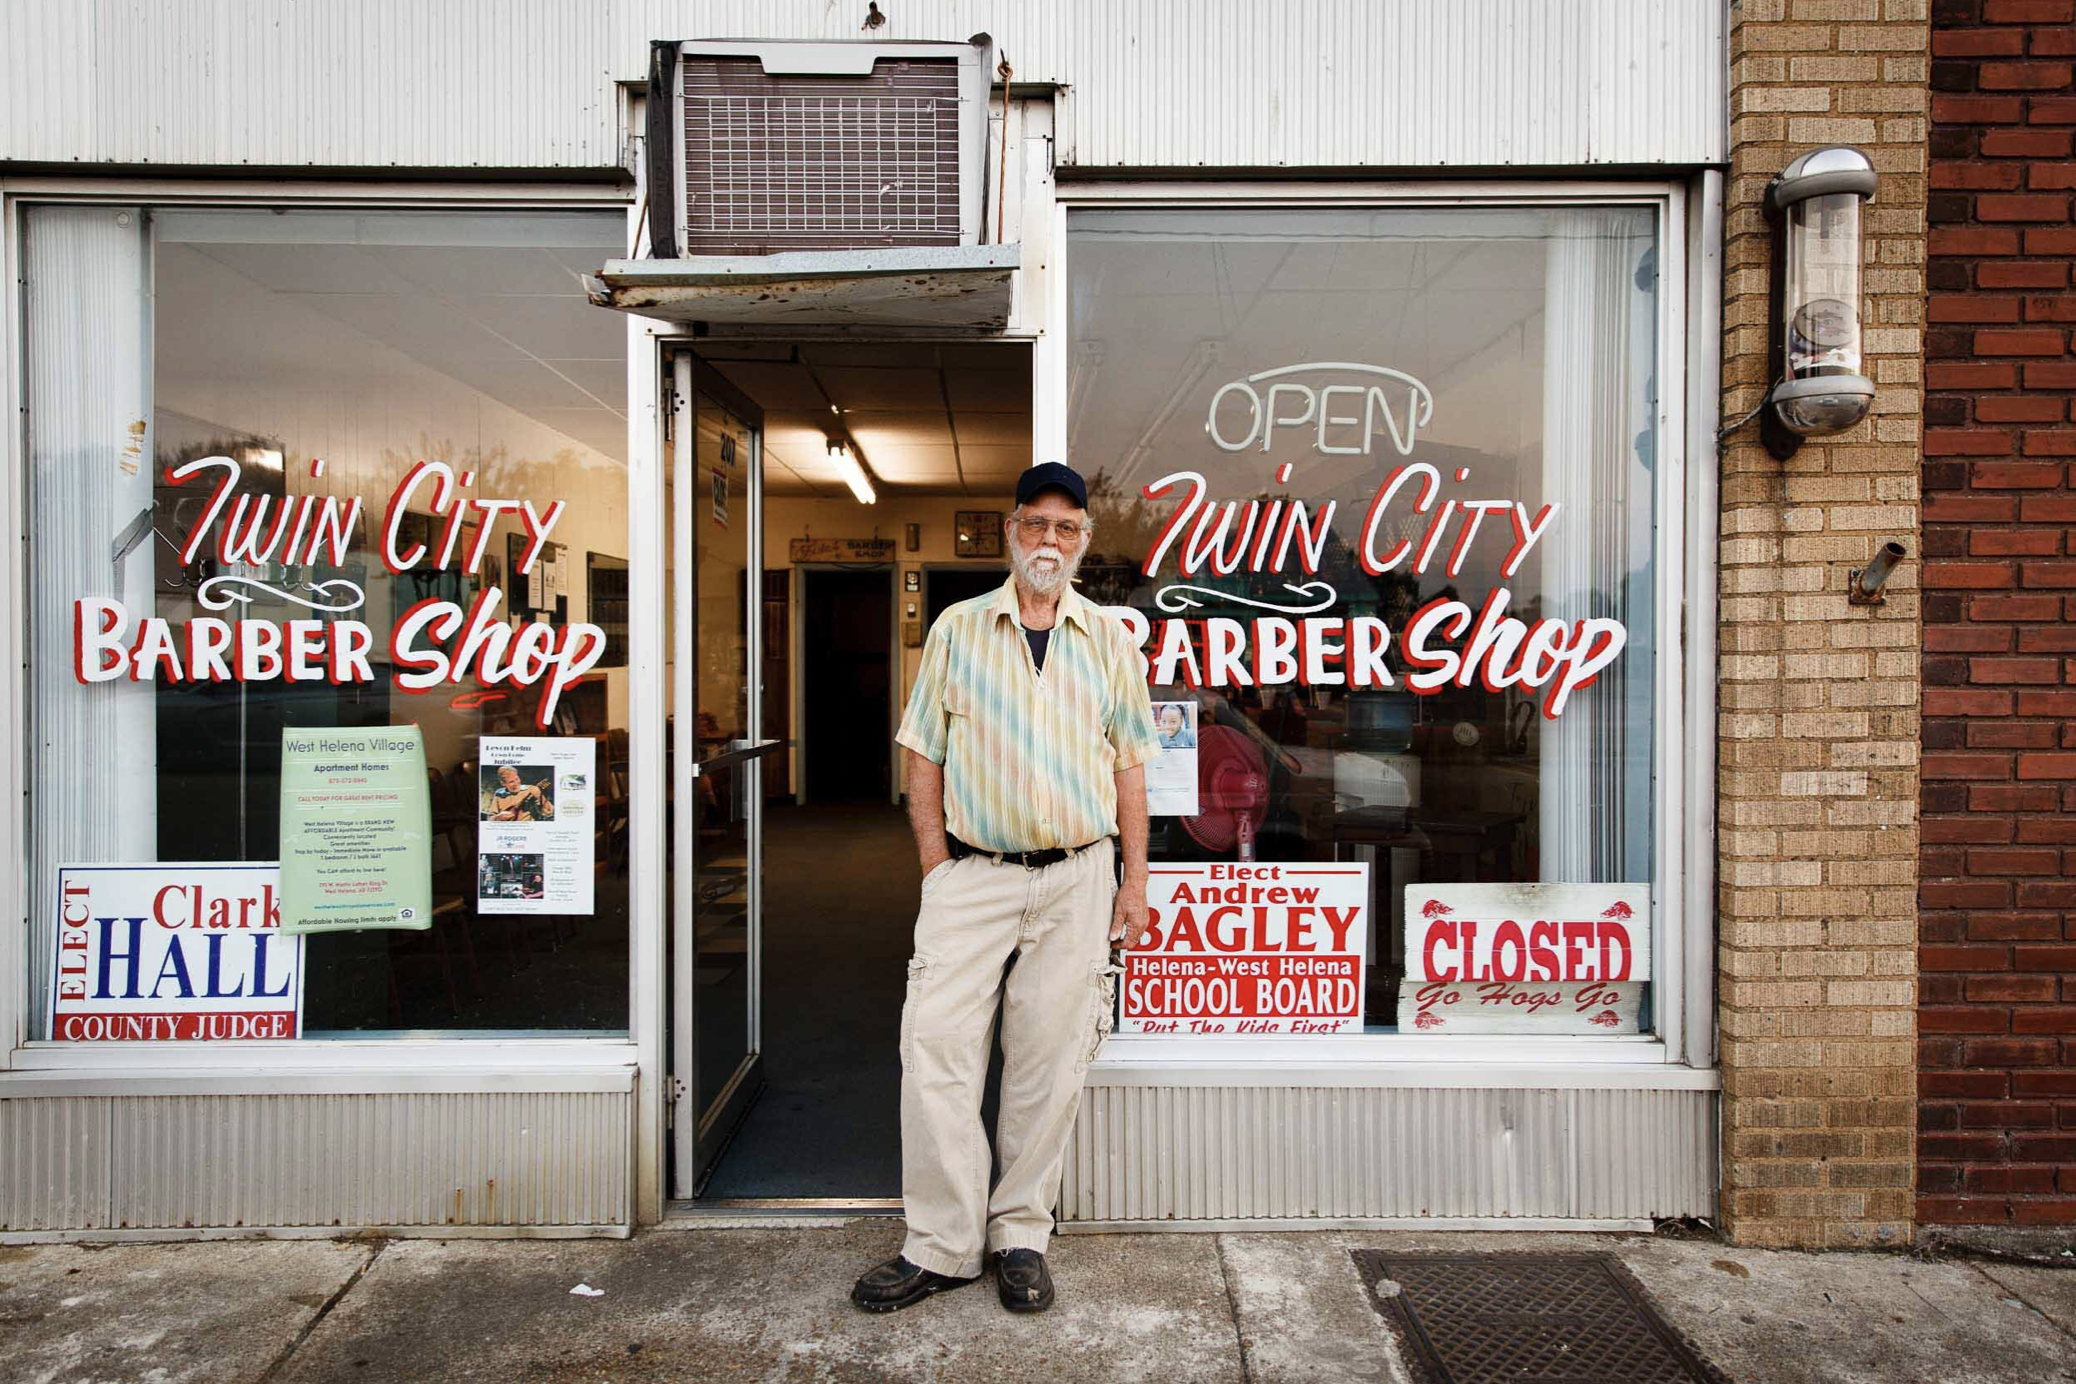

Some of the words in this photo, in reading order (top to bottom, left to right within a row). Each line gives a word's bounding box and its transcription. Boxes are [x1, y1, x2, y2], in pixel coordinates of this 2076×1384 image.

[1206, 382, 1420, 456] OPEN
[74, 597, 375, 685] BARBER
[392, 586, 607, 727] Shop
[1401, 587, 1628, 720] Shop
[286, 740, 315, 752] West
[320, 739, 365, 752] Helena
[369, 738, 415, 753] Village
[314, 764, 359, 774] Apartment
[361, 763, 389, 771] Homes
[1210, 865, 1281, 880] Elect
[153, 885, 280, 929] Clark
[1170, 882, 1320, 904] Andrew
[378, 915, 396, 923] apply
[60, 880, 90, 1003] ELECT
[91, 918, 290, 998] HALL
[1423, 920, 1632, 982] CLOSED
[1133, 958, 1270, 976] Helena-West
[1279, 957, 1352, 976] Helena
[1128, 978, 1243, 1015] SCHOOL
[1256, 978, 1356, 1015] BOARD
[1415, 982, 1462, 1012] Go
[1476, 984, 1562, 1014] Hogs
[1574, 982, 1622, 1013] Go
[64, 1016, 182, 1041] COUNTY
[191, 1014, 288, 1040] JUDGE
